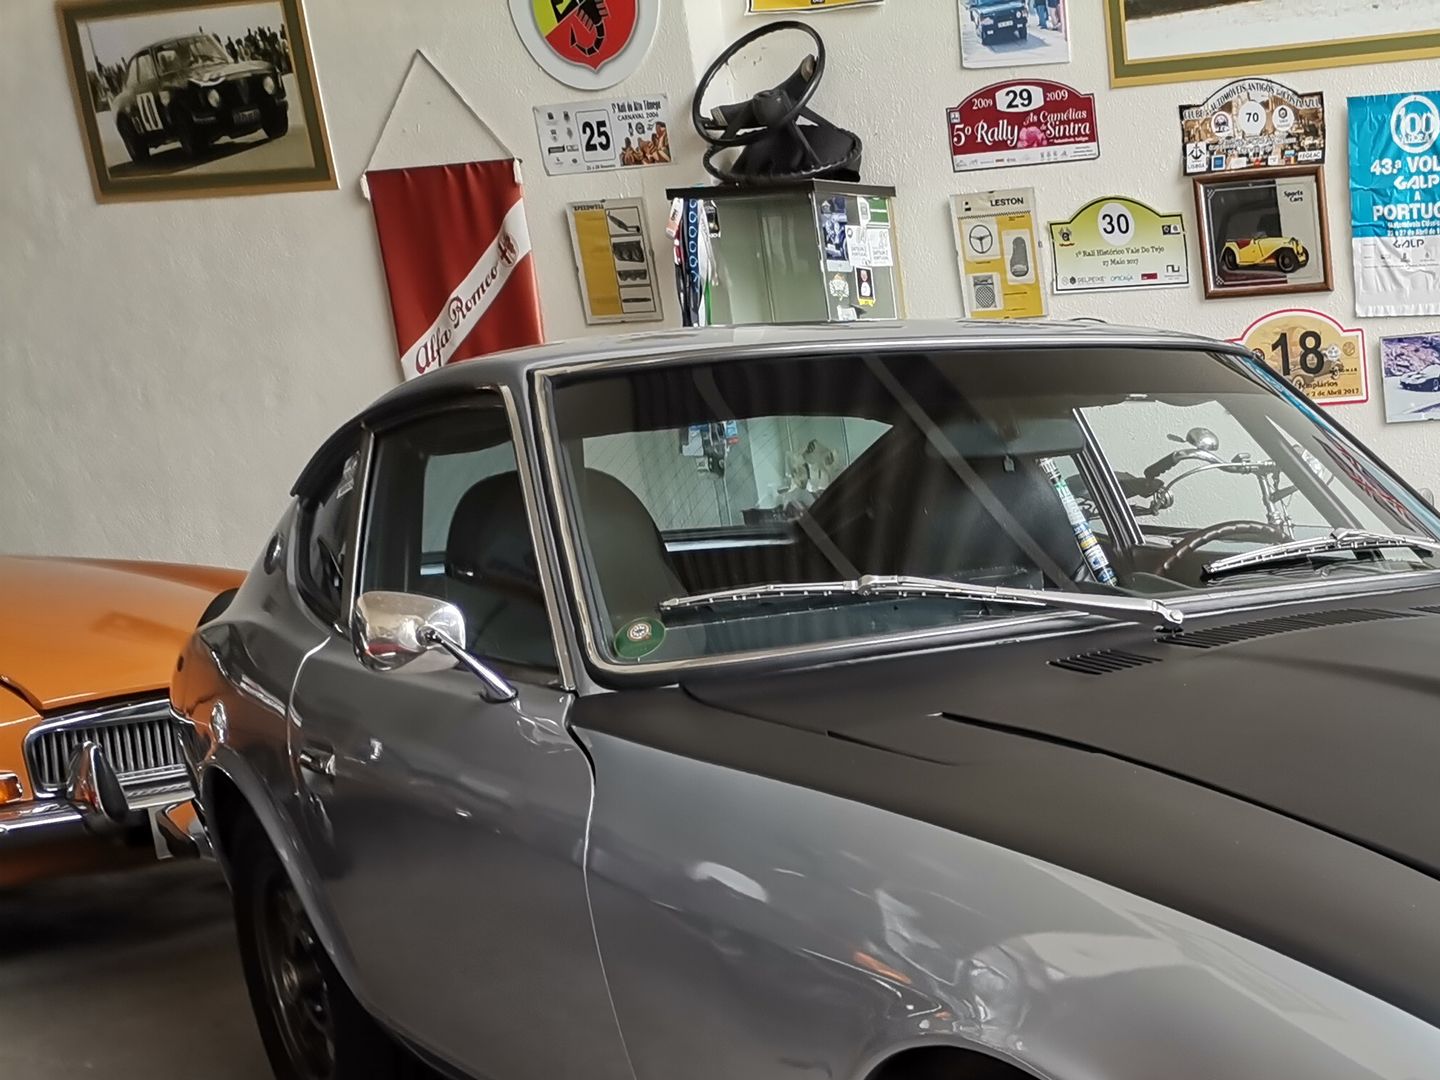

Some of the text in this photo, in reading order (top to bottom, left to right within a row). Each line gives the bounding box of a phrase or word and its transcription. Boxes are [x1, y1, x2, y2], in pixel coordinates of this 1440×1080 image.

[1046, 89, 1069, 101] 2009
[1247, 82, 1274, 96] ANTIGOS
[971, 98, 993, 110] 2009
[1005, 88, 1033, 109] 29
[1039, 107, 1088, 122] Camélias
[1246, 112, 1259, 123] 70
[582, 120, 611, 152] 25
[953, 119, 1019, 147] 5º Rally
[1046, 119, 1091, 138] Sintra
[1394, 174, 1440, 190] GALP
[990, 196, 1025, 207] LESTON
[1283, 190, 1303, 198] Sports
[1414, 190, 1421, 201] A
[1102, 213, 1130, 235] 30
[1125, 246, 1140, 254] Vale
[415, 264, 499, 374] Alfa Romeo
[1271, 330, 1325, 377] 18
